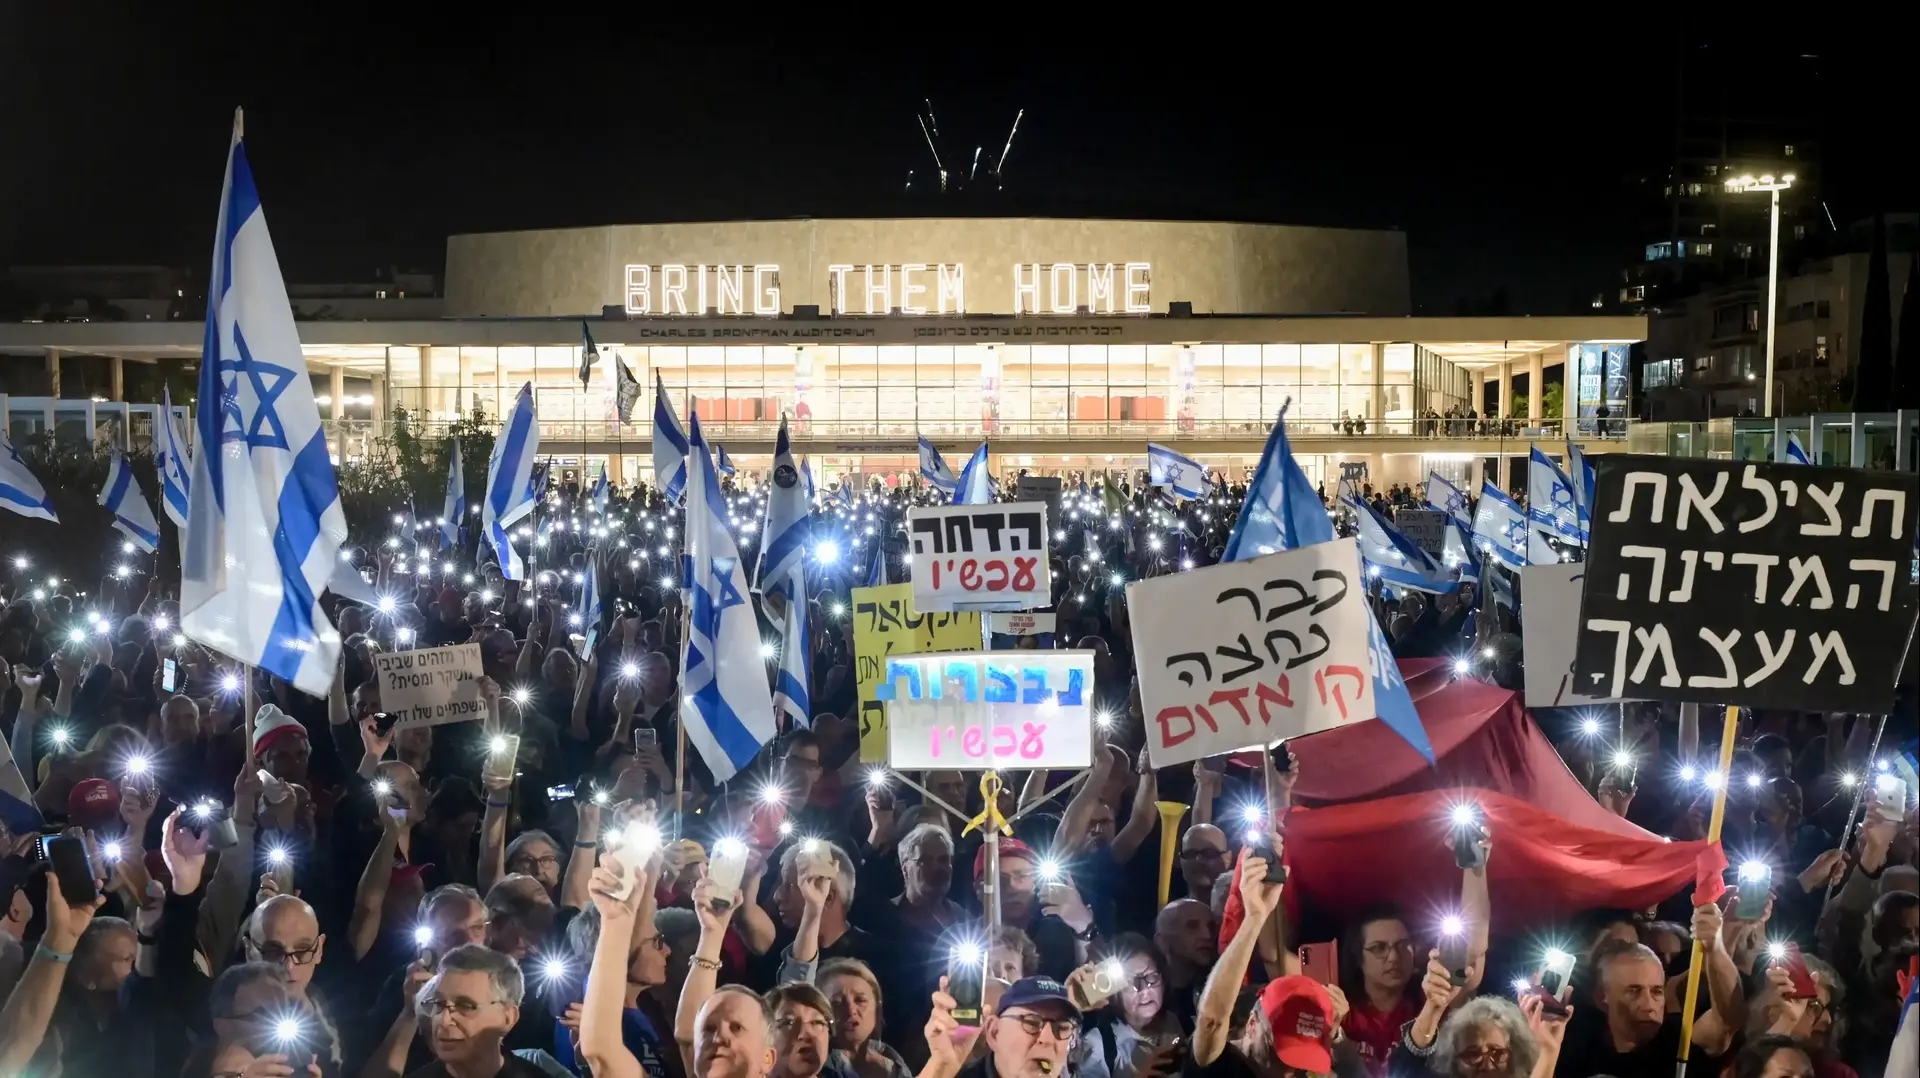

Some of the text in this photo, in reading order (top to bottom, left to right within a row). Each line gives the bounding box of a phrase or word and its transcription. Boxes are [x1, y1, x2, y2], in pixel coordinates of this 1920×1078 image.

[625, 262, 1150, 315] BRING THEM HOME
[640, 327, 876, 338] CHARLES BRONFMAN AUDITORIUM
[913, 327, 966, 337] ברונפמן
[1036, 326, 1088, 336] התרבות
[1090, 325, 1123, 336] היכל
[1608, 351, 1628, 382] JAZZ
[912, 512, 1043, 555] הדחה
[931, 555, 1039, 592] עכשיו
[1615, 544, 1897, 612] המדינה
[1216, 568, 1349, 623] כבר
[378, 647, 479, 671] איך מזהים שביבי
[1165, 623, 1331, 689] נחצה
[388, 672, 433, 690] ומסית?
[875, 660, 1085, 707] נבצרות
[1314, 664, 1365, 720] קו
[412, 703, 432, 721] שלו
[436, 699, 486, 717] השפתיים
[1155, 672, 1294, 749] אדום
[929, 721, 1047, 760] עכשיו
